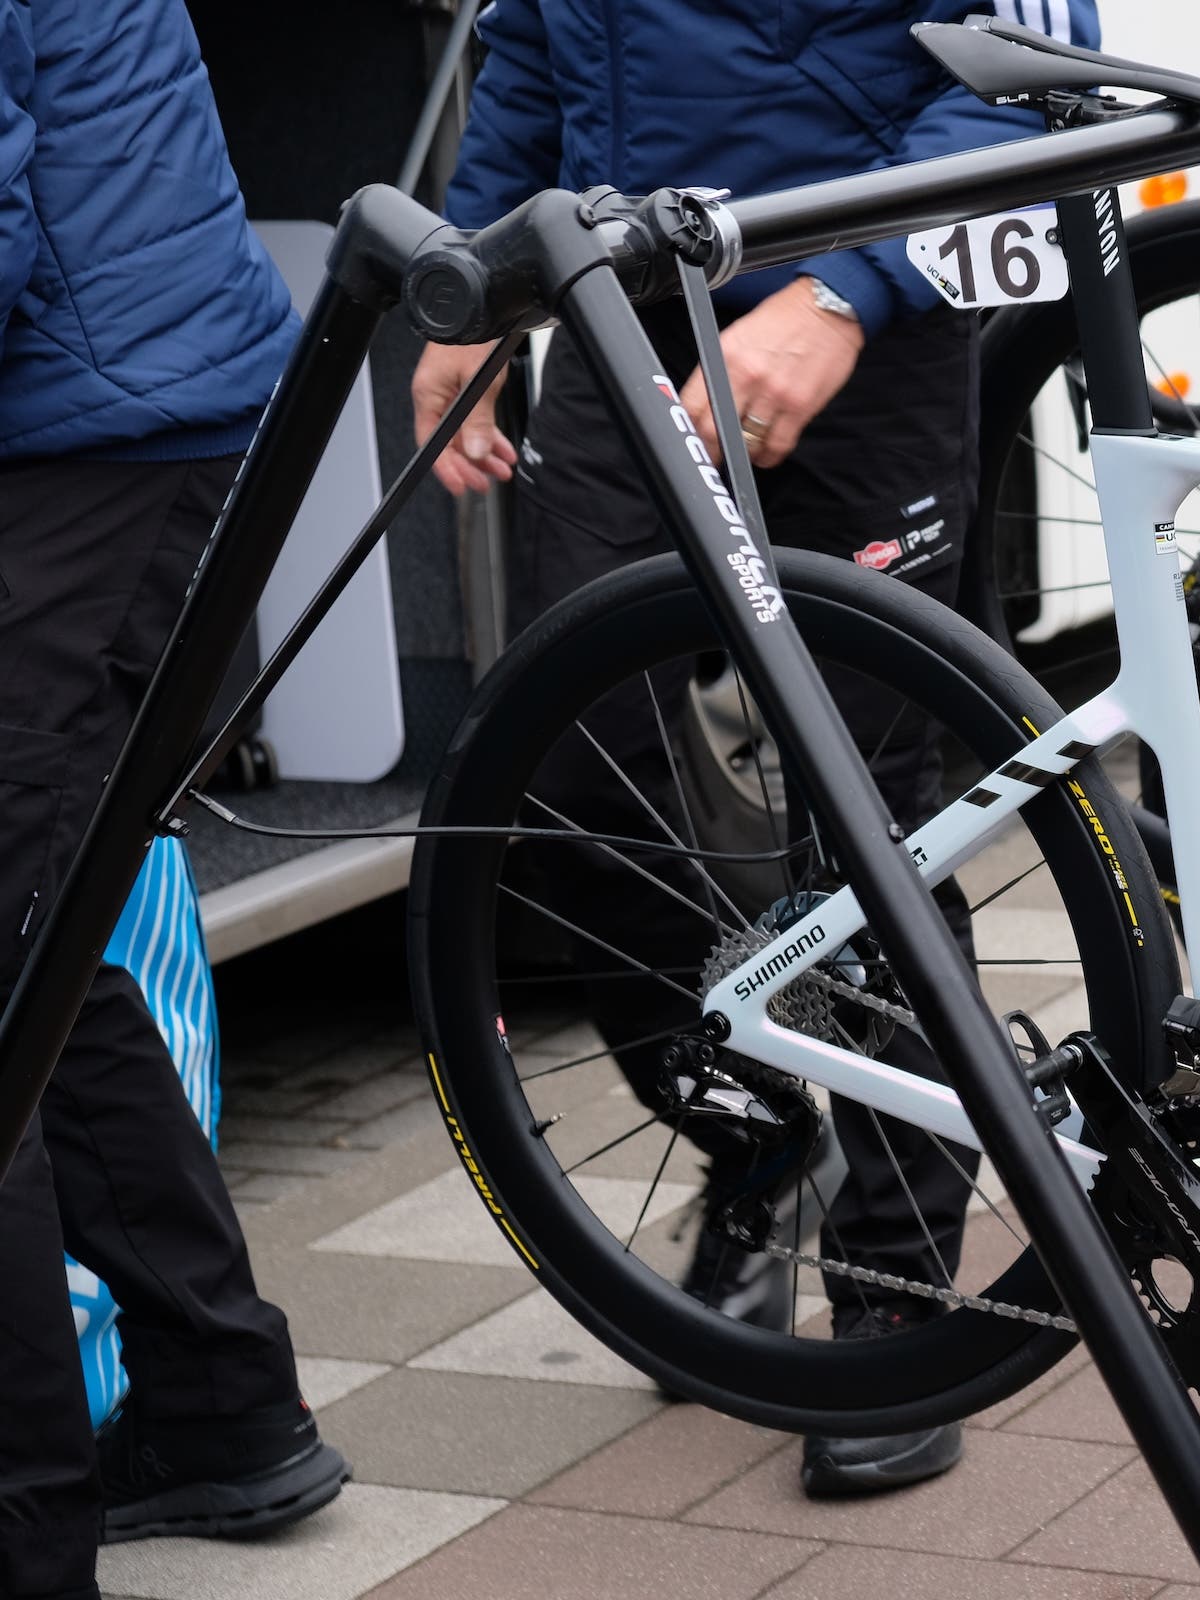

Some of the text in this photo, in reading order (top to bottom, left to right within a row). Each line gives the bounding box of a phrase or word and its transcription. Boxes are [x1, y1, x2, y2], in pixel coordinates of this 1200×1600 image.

[926, 264, 940, 280] UCI
[938, 218, 1041, 303] 16
[726, 552, 776, 624] SPORTS
[1067, 779, 1116, 855] ZERO
[733, 923, 826, 1002] SHIMANO
[446, 1115, 504, 1216] PIRELLI
